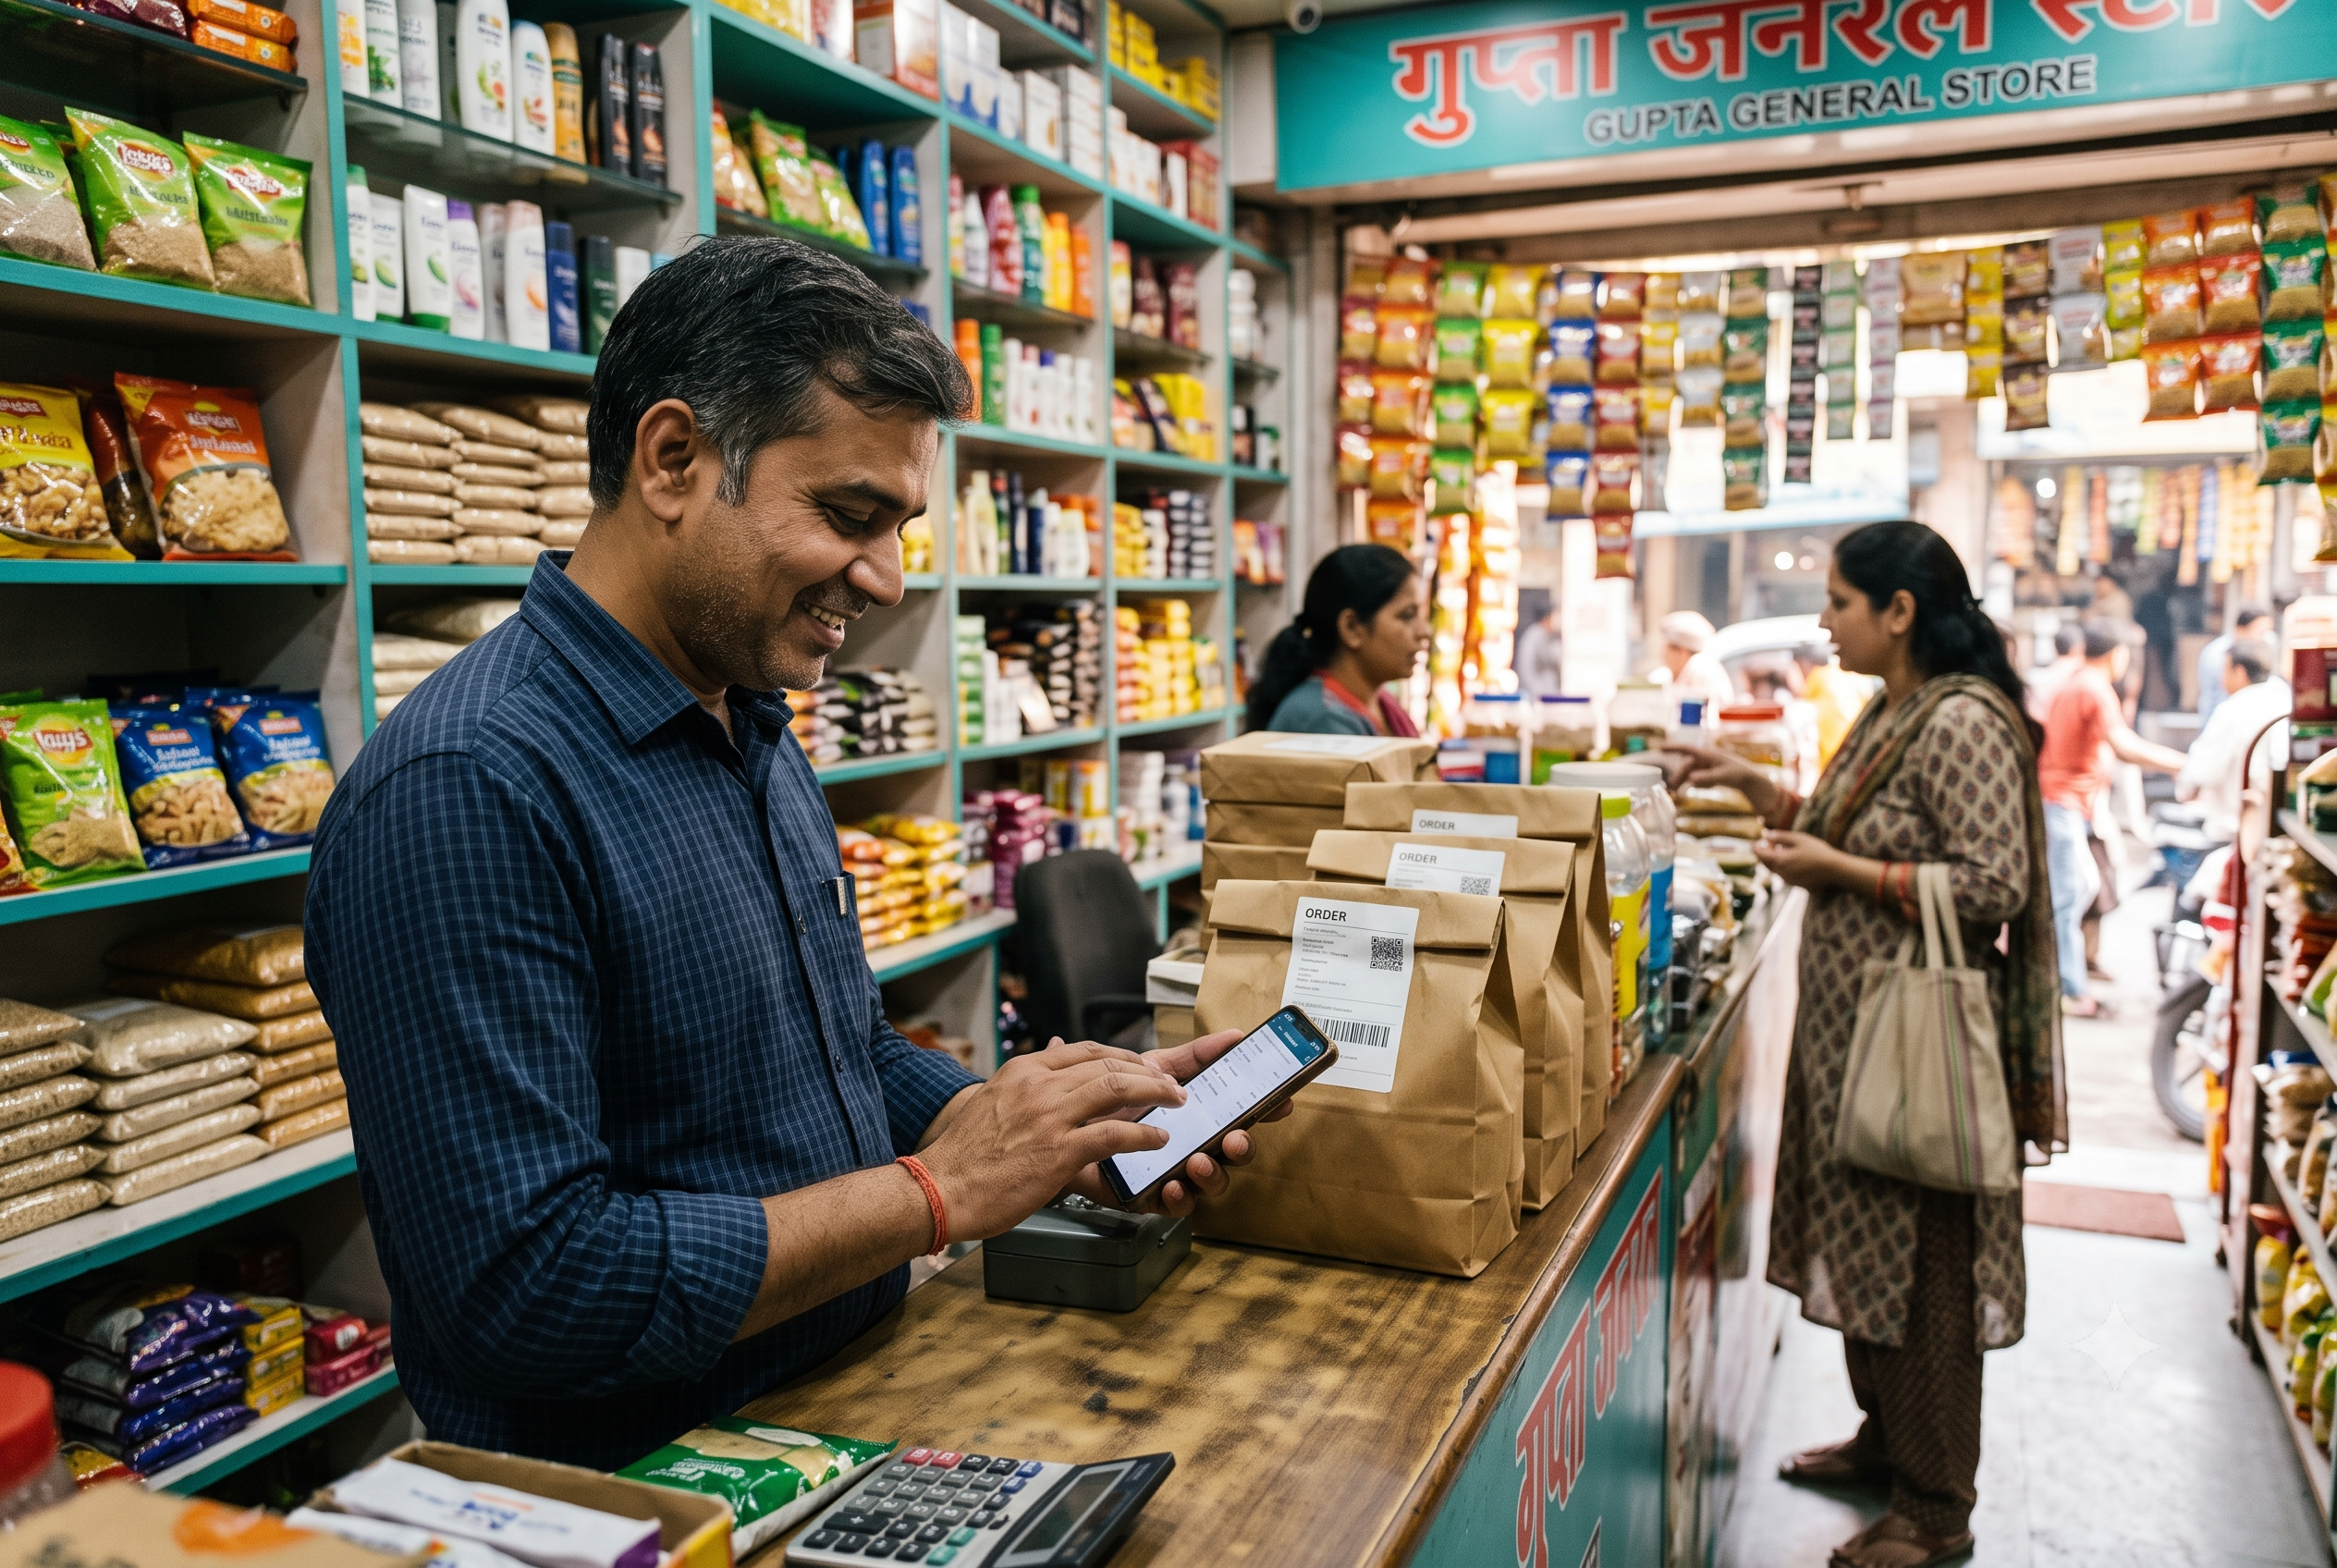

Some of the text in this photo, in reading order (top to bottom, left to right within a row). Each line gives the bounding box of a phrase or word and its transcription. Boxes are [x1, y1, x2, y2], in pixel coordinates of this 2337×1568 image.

[1390, 13, 1626, 145] गुप्ता
[1646, 0, 1992, 81] जनरल
[1588, 56, 2094, 144] GUPTA GENERAL STORE
[1419, 819, 1455, 830] ORDER
[1399, 851, 1438, 864] ORDER
[1304, 908, 1347, 922] ORDER
